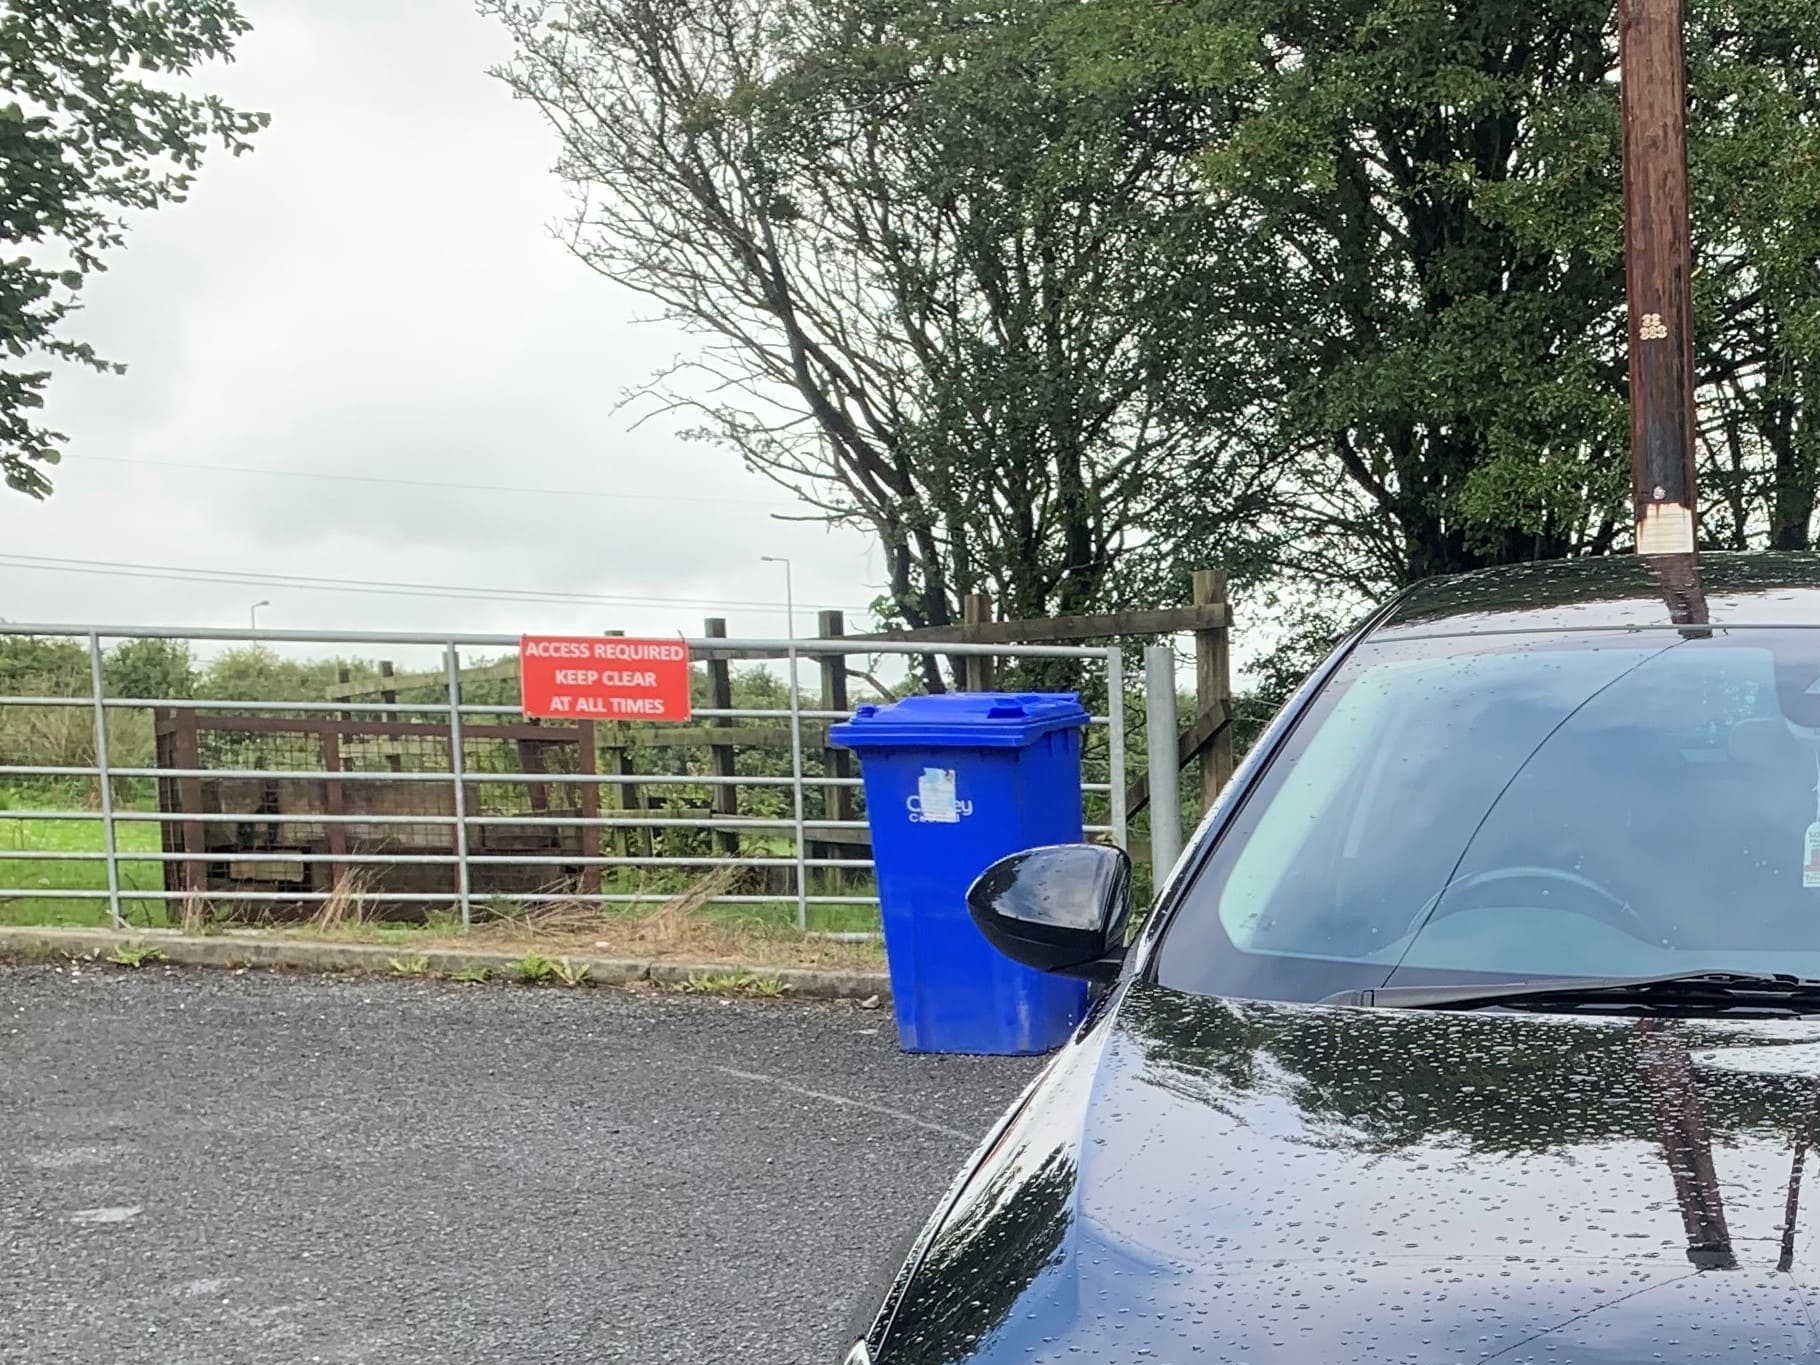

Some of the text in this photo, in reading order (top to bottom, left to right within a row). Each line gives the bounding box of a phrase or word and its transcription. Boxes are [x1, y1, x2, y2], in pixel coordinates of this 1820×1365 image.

[526, 641, 683, 661] ACCESS REQUIRED
[555, 670, 657, 686] KEEP CLEAR
[550, 696, 664, 713] AT ALL TIMES
